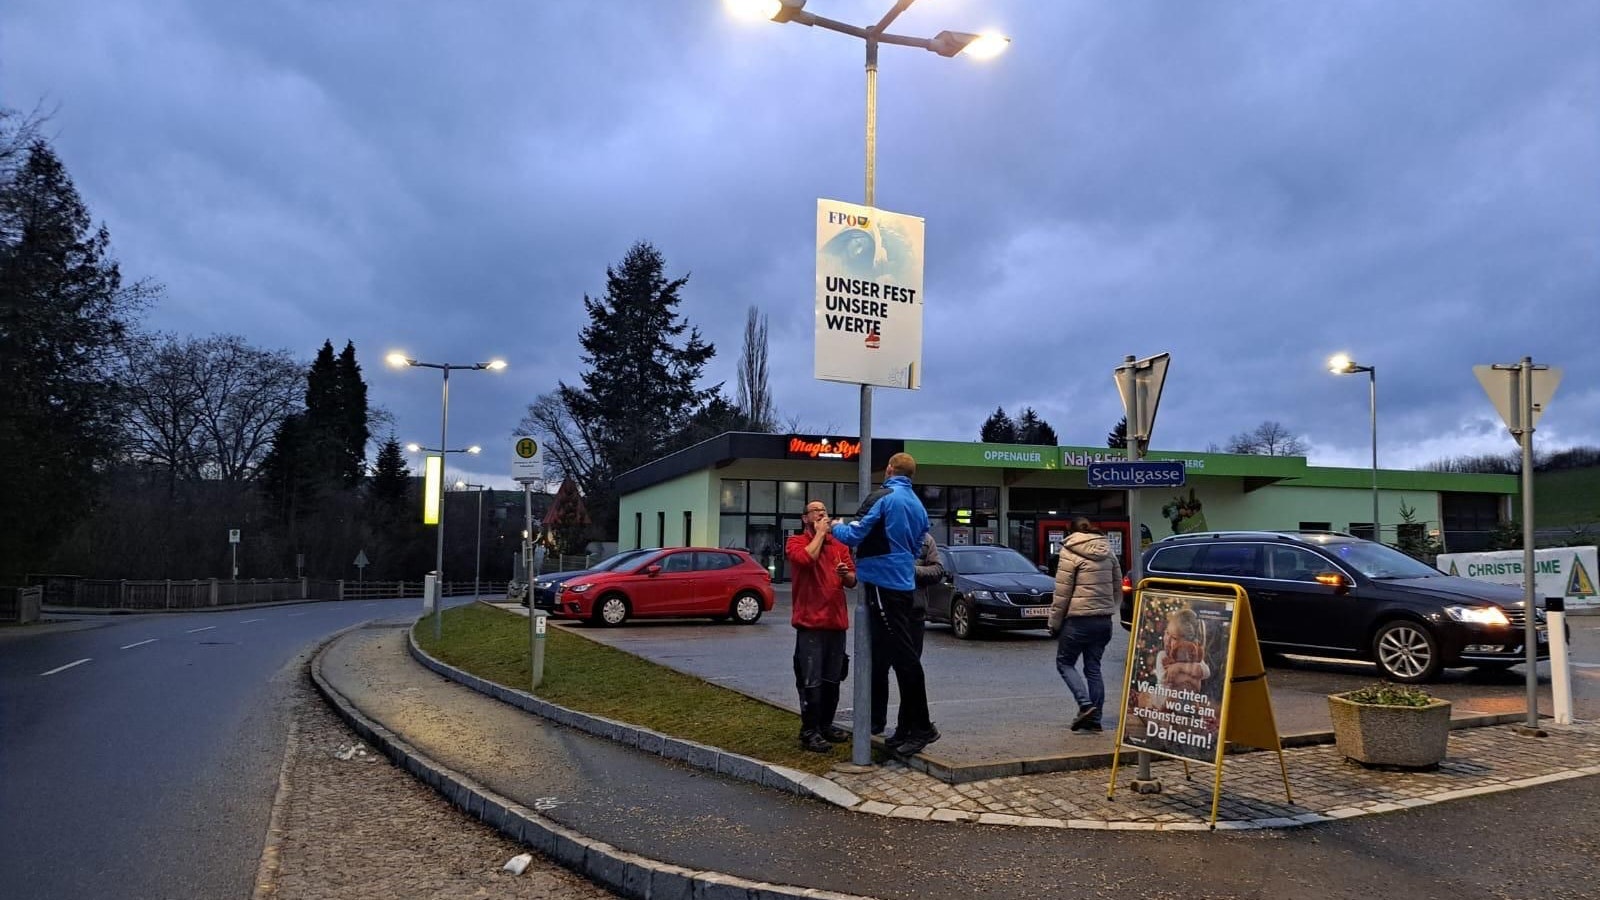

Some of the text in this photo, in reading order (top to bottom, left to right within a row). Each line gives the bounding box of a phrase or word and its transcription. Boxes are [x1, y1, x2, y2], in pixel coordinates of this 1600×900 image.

[826, 276, 916, 304] UNSER FEST
[825, 295, 888, 318] UNSERE
[825, 314, 881, 336] WERTE
[790, 438, 861, 458] Magic Styl
[1092, 467, 1180, 484] Schulgasse
[1467, 559, 1561, 577] CHRISTBUME
[1137, 680, 1211, 707] Weihnachten,
[1133, 706, 1207, 730] schönsten ist:
[1165, 700, 1215, 718] wo es am
[1146, 720, 1212, 750] Daheim!
